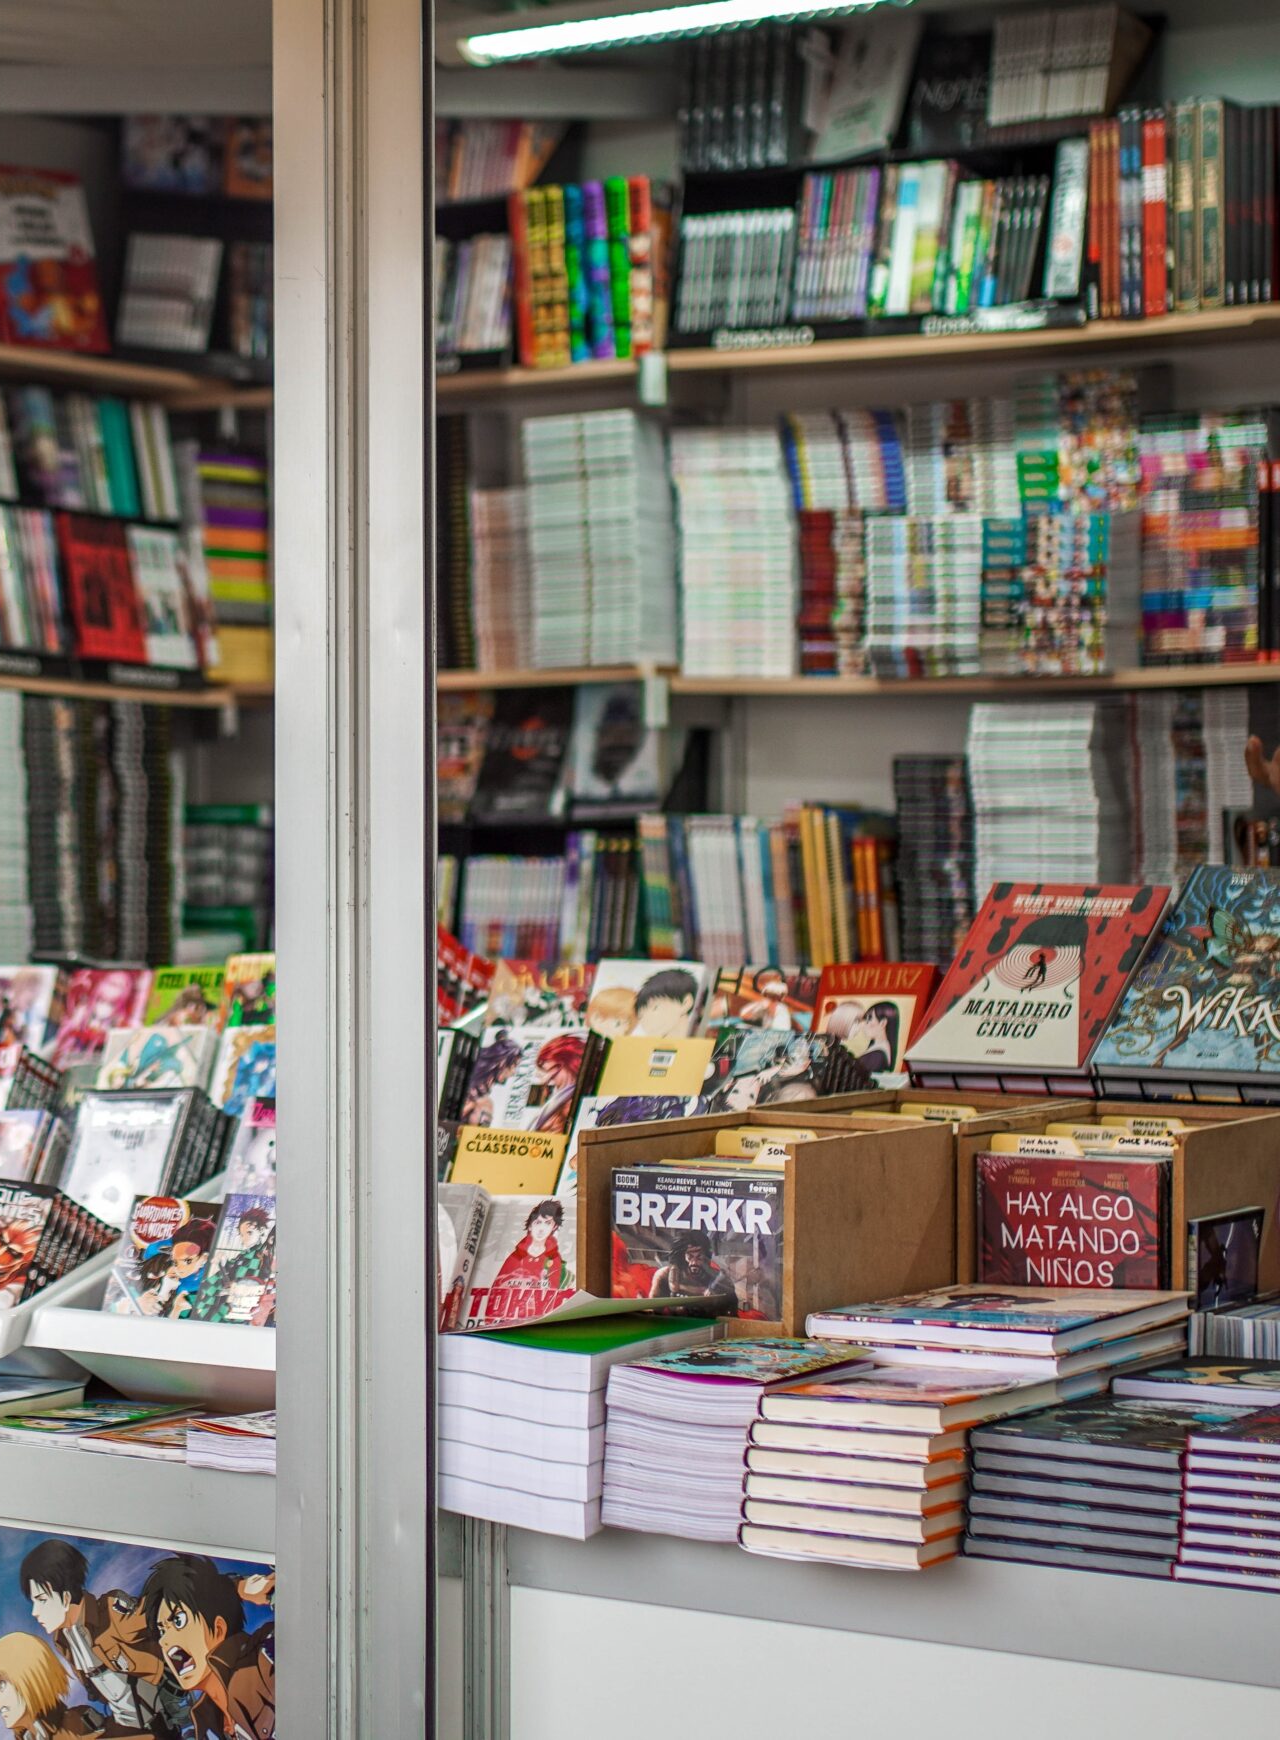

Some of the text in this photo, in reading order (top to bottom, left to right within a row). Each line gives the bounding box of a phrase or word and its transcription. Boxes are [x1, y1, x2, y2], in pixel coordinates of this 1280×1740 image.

[1013, 894, 1134, 913] KURT VONNEGUT
[962, 999, 1073, 1020] MATADERO
[976, 1021, 1039, 1039] CINCO
[475, 1132, 552, 1146] ASSASSINATION
[465, 1141, 554, 1160] CLASSROOM
[617, 1174, 639, 1185] BOOM!
[657, 1176, 676, 1184] KEANU
[677, 1178, 697, 1186] REEVES
[748, 1183, 778, 1194] forum
[706, 1187, 735, 1195] CRABTREE
[615, 1191, 773, 1235] BRZRKR
[1006, 1191, 1134, 1221] HAY ALGO
[1001, 1221, 1141, 1255] MATANDO
[462, 1259, 469, 1273] 6
[1026, 1256, 1115, 1288] NIÑOS
